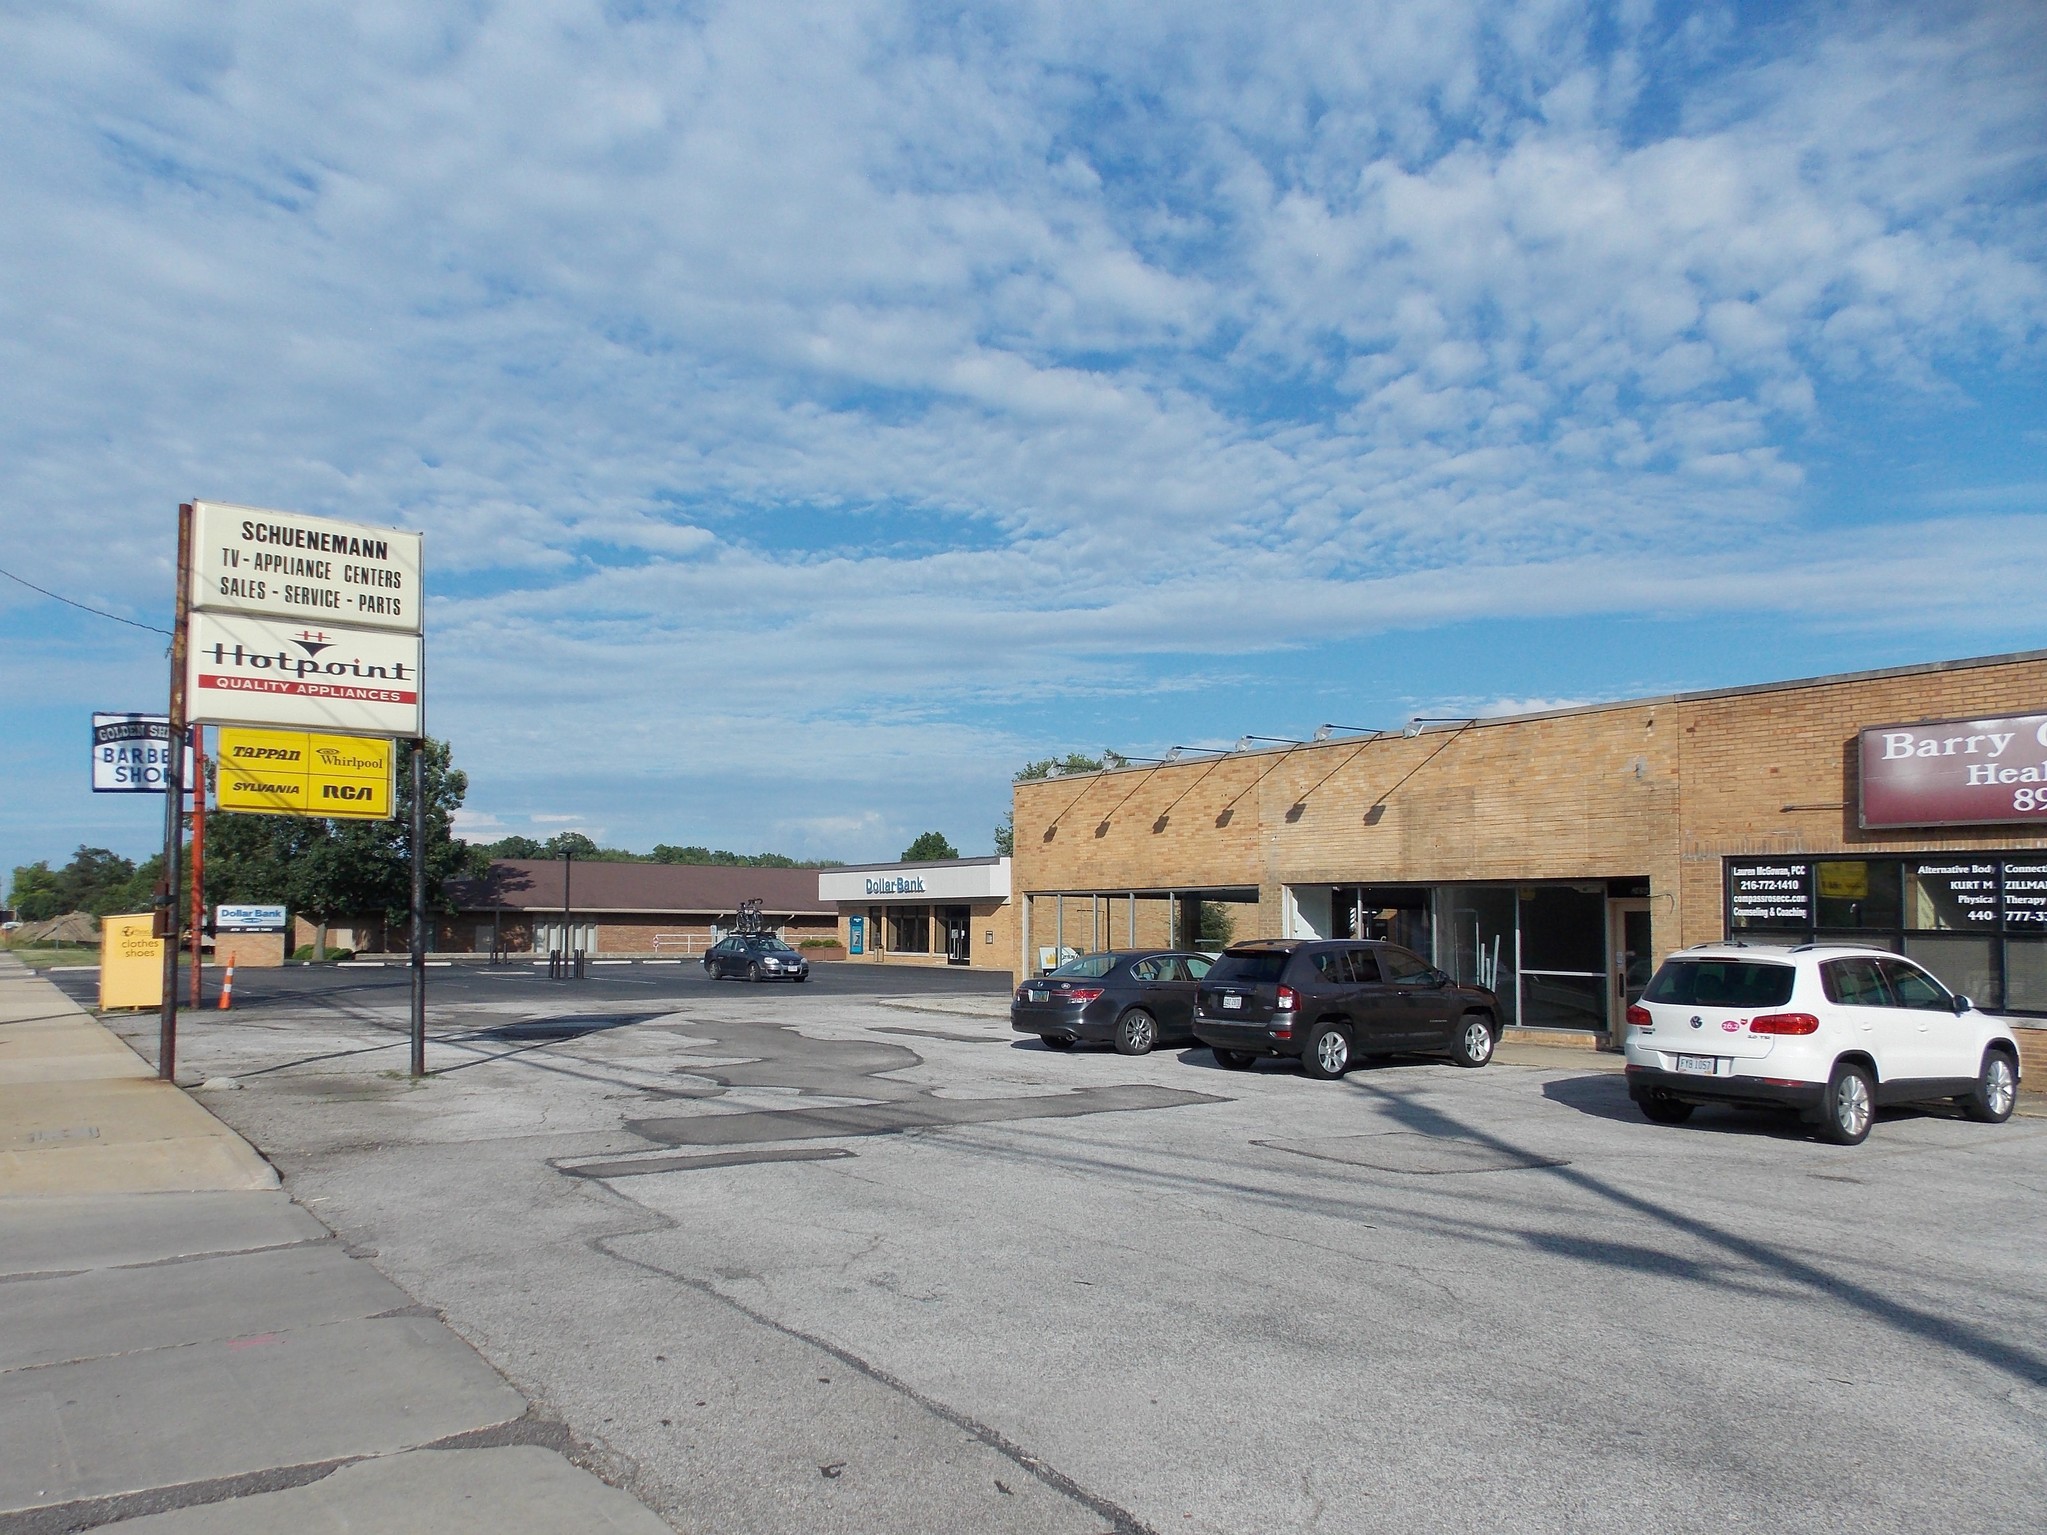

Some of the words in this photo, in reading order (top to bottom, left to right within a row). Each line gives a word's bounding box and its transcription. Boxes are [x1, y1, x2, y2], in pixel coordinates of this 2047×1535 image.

[242, 520, 388, 560] SCHUENEMANN
[344, 564, 402, 589] CENTERS
[220, 576, 266, 600] SALES
[284, 584, 340, 609] SERVICE
[359, 594, 401, 616] PARTS
[201, 643, 416, 681] Hotpoint
[216, 677, 290, 693] QUALITY
[296, 684, 401, 702] APPLIANCES
[100, 724, 145, 741] GOLDEN
[1881, 732, 2016, 760] Barry
[103, 747, 169, 764] BARBE
[232, 746, 301, 762] TAPPAN
[321, 754, 383, 770] Whirlpool
[232, 782, 300, 794] SYLVANIA
[323, 784, 372, 801] RCA
[1733, 866, 1756, 876] Lauren
[1790, 866, 1806, 876] PCC
[1918, 866, 1970, 874] Alternative
[1972, 864, 1996, 874] Body
[1740, 880, 1799, 890] 216-772-1410
[1950, 880, 1980, 890] KURT
[1733, 895, 1808, 905] compassrosecc.com
[1958, 895, 1997, 905] Physical
[2004, 894, 2047, 906] Therapy
[221, 909, 253, 918] Dollar
[254, 910, 282, 918] Bank
[1733, 906, 1768, 919] Counseling
[1769, 906, 1776, 916] &
[1776, 906, 1808, 919] Coaching
[122, 940, 159, 948] clothes
[125, 949, 155, 958] shoes
[1722, 1023, 1739, 1031] 26.2
